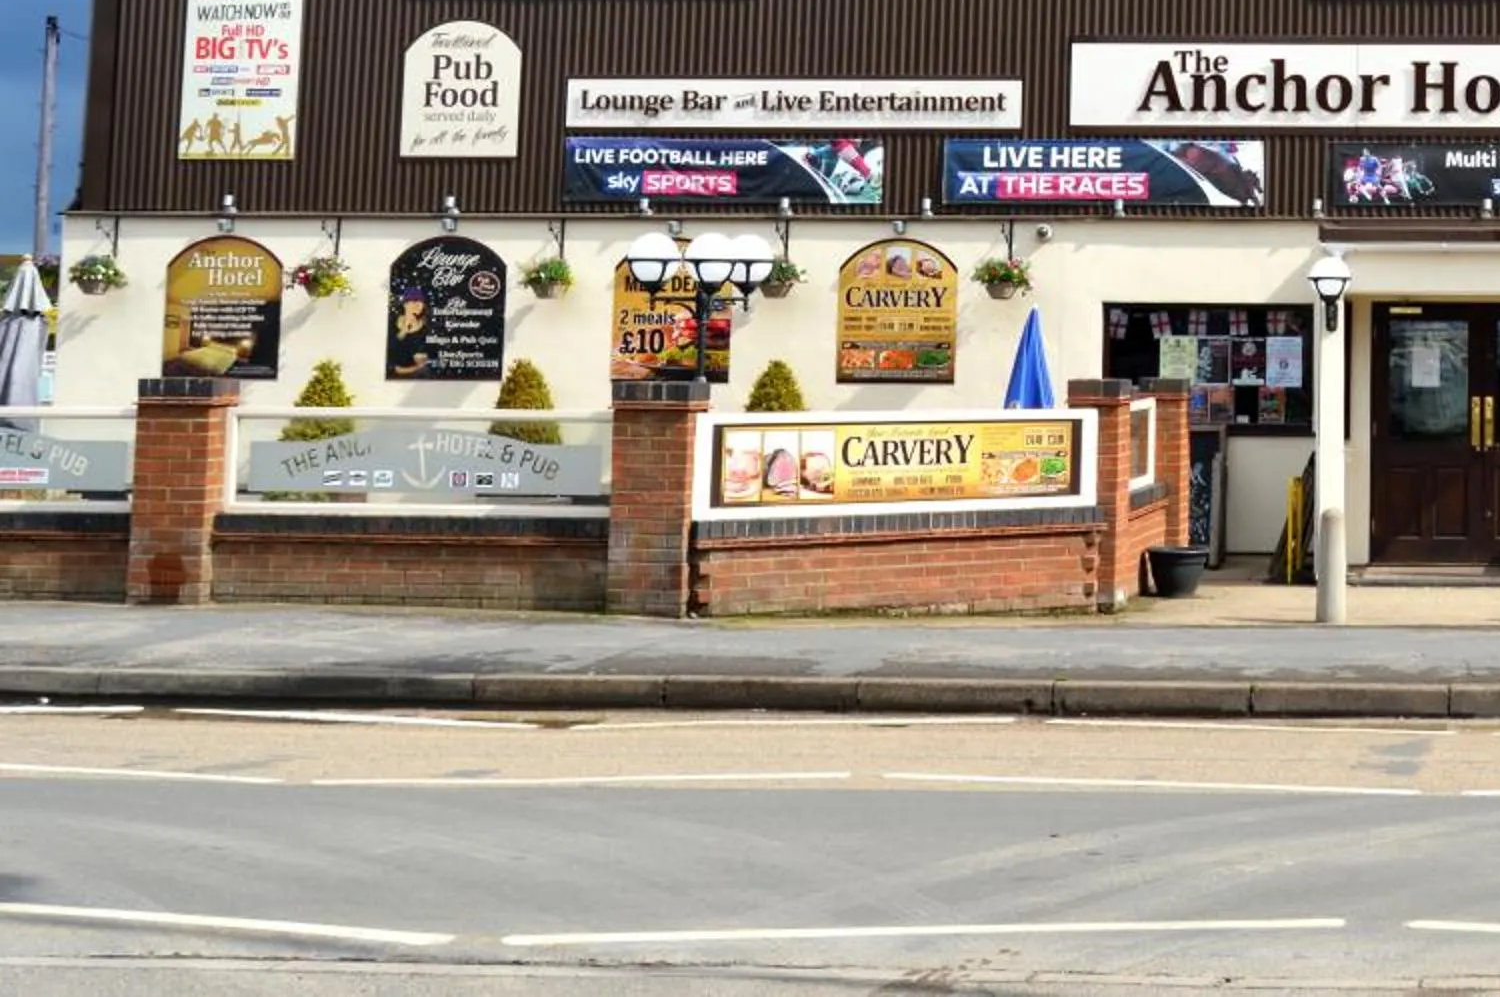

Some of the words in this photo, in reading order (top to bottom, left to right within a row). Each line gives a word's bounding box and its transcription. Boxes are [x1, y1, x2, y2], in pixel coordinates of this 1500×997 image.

[197, 5, 241, 21] WATCH
[243, 4, 277, 20] NOW
[221, 25, 242, 37] Full
[245, 25, 266, 36] HD
[195, 36, 236, 59] BIG
[245, 38, 289, 59] TV's
[432, 53, 494, 80] Pub
[1174, 49, 1229, 73] The
[423, 80, 499, 108] Food
[1135, 58, 1391, 113] Anchor
[580, 89, 675, 117] Lounge
[681, 90, 728, 111] Bar
[734, 94, 756, 109] and
[761, 89, 812, 112] Live
[818, 90, 1007, 112] Entertainment
[423, 111, 465, 123] served
[466, 110, 497, 124] daily
[574, 148, 615, 164] LIVE
[618, 148, 717, 165] FOOTBALL
[720, 150, 769, 166] HERE
[983, 146, 1043, 168] LIVE
[1050, 146, 1123, 168] HERE
[1445, 150, 1497, 168] Multi
[607, 171, 640, 193] sky
[646, 174, 732, 193] SPORTS
[959, 174, 995, 195] AT
[1003, 175, 1053, 195] THE
[1058, 175, 1145, 195] RACES
[187, 250, 265, 268] Anchor
[417, 246, 481, 274] Lounge
[207, 268, 264, 286] Hotel
[844, 286, 948, 309] CARVERY
[620, 309, 631, 326] 2
[633, 310, 678, 326] meals
[619, 328, 665, 354] £10
[48, 444, 89, 477] PUB
[435, 432, 494, 460] HOTEL
[500, 444, 514, 464] &
[519, 449, 559, 480] PUB
[841, 434, 975, 468] CARVERY
[281, 448, 319, 478] THE
